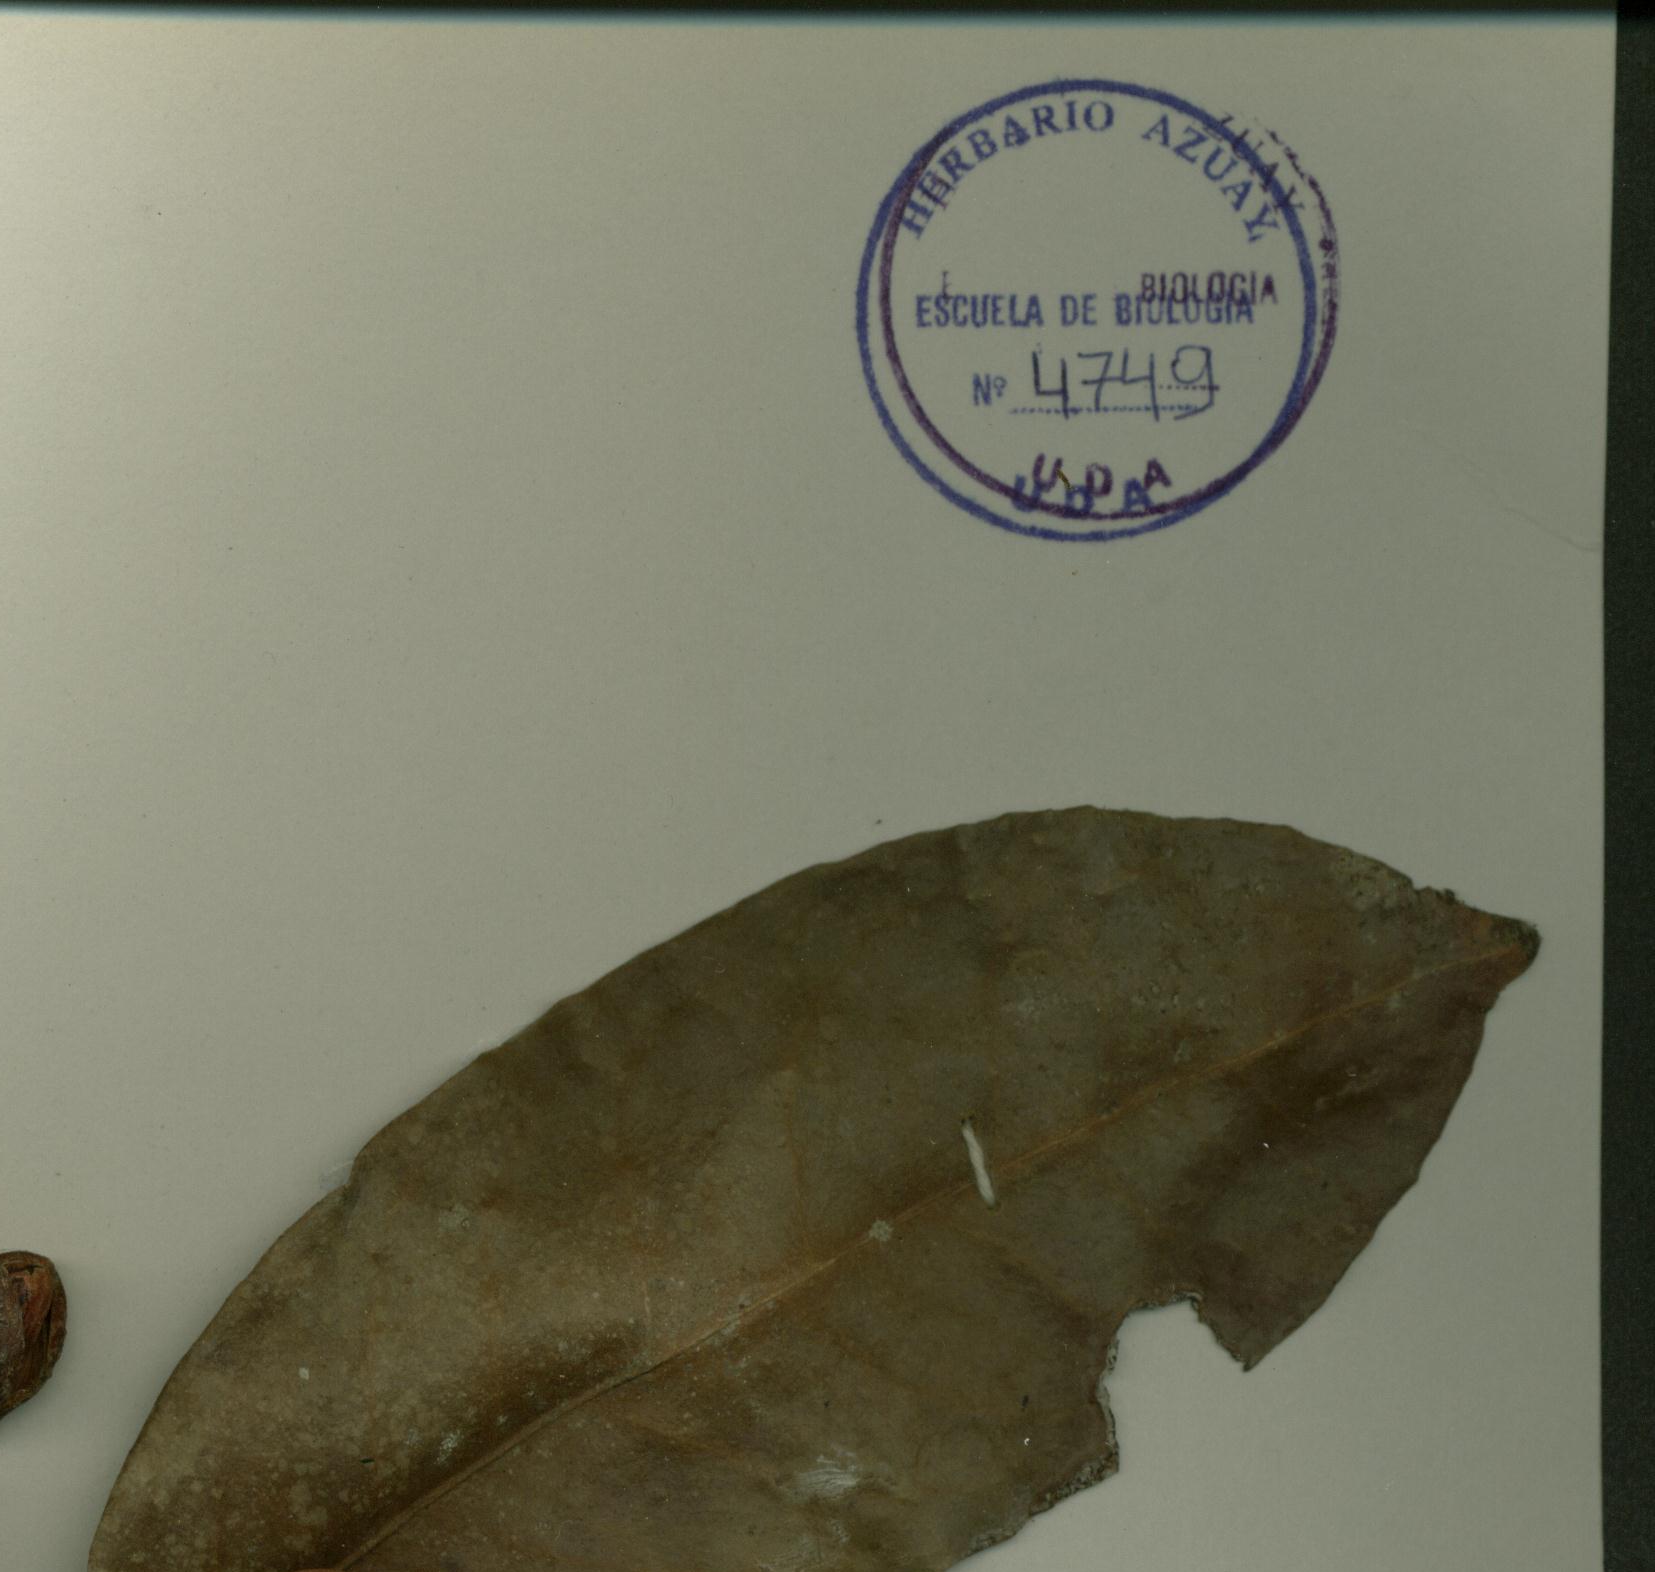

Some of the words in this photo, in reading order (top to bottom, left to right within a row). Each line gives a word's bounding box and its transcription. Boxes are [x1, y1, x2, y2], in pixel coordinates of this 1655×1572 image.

[898, 99, 1116, 242] HERBARIO
[1141, 112, 1281, 243] AZUAY
[914, 294, 1044, 329] ESCUELA
[1060, 292, 1098, 328] DE
[1031, 343, 1219, 422] 4749
